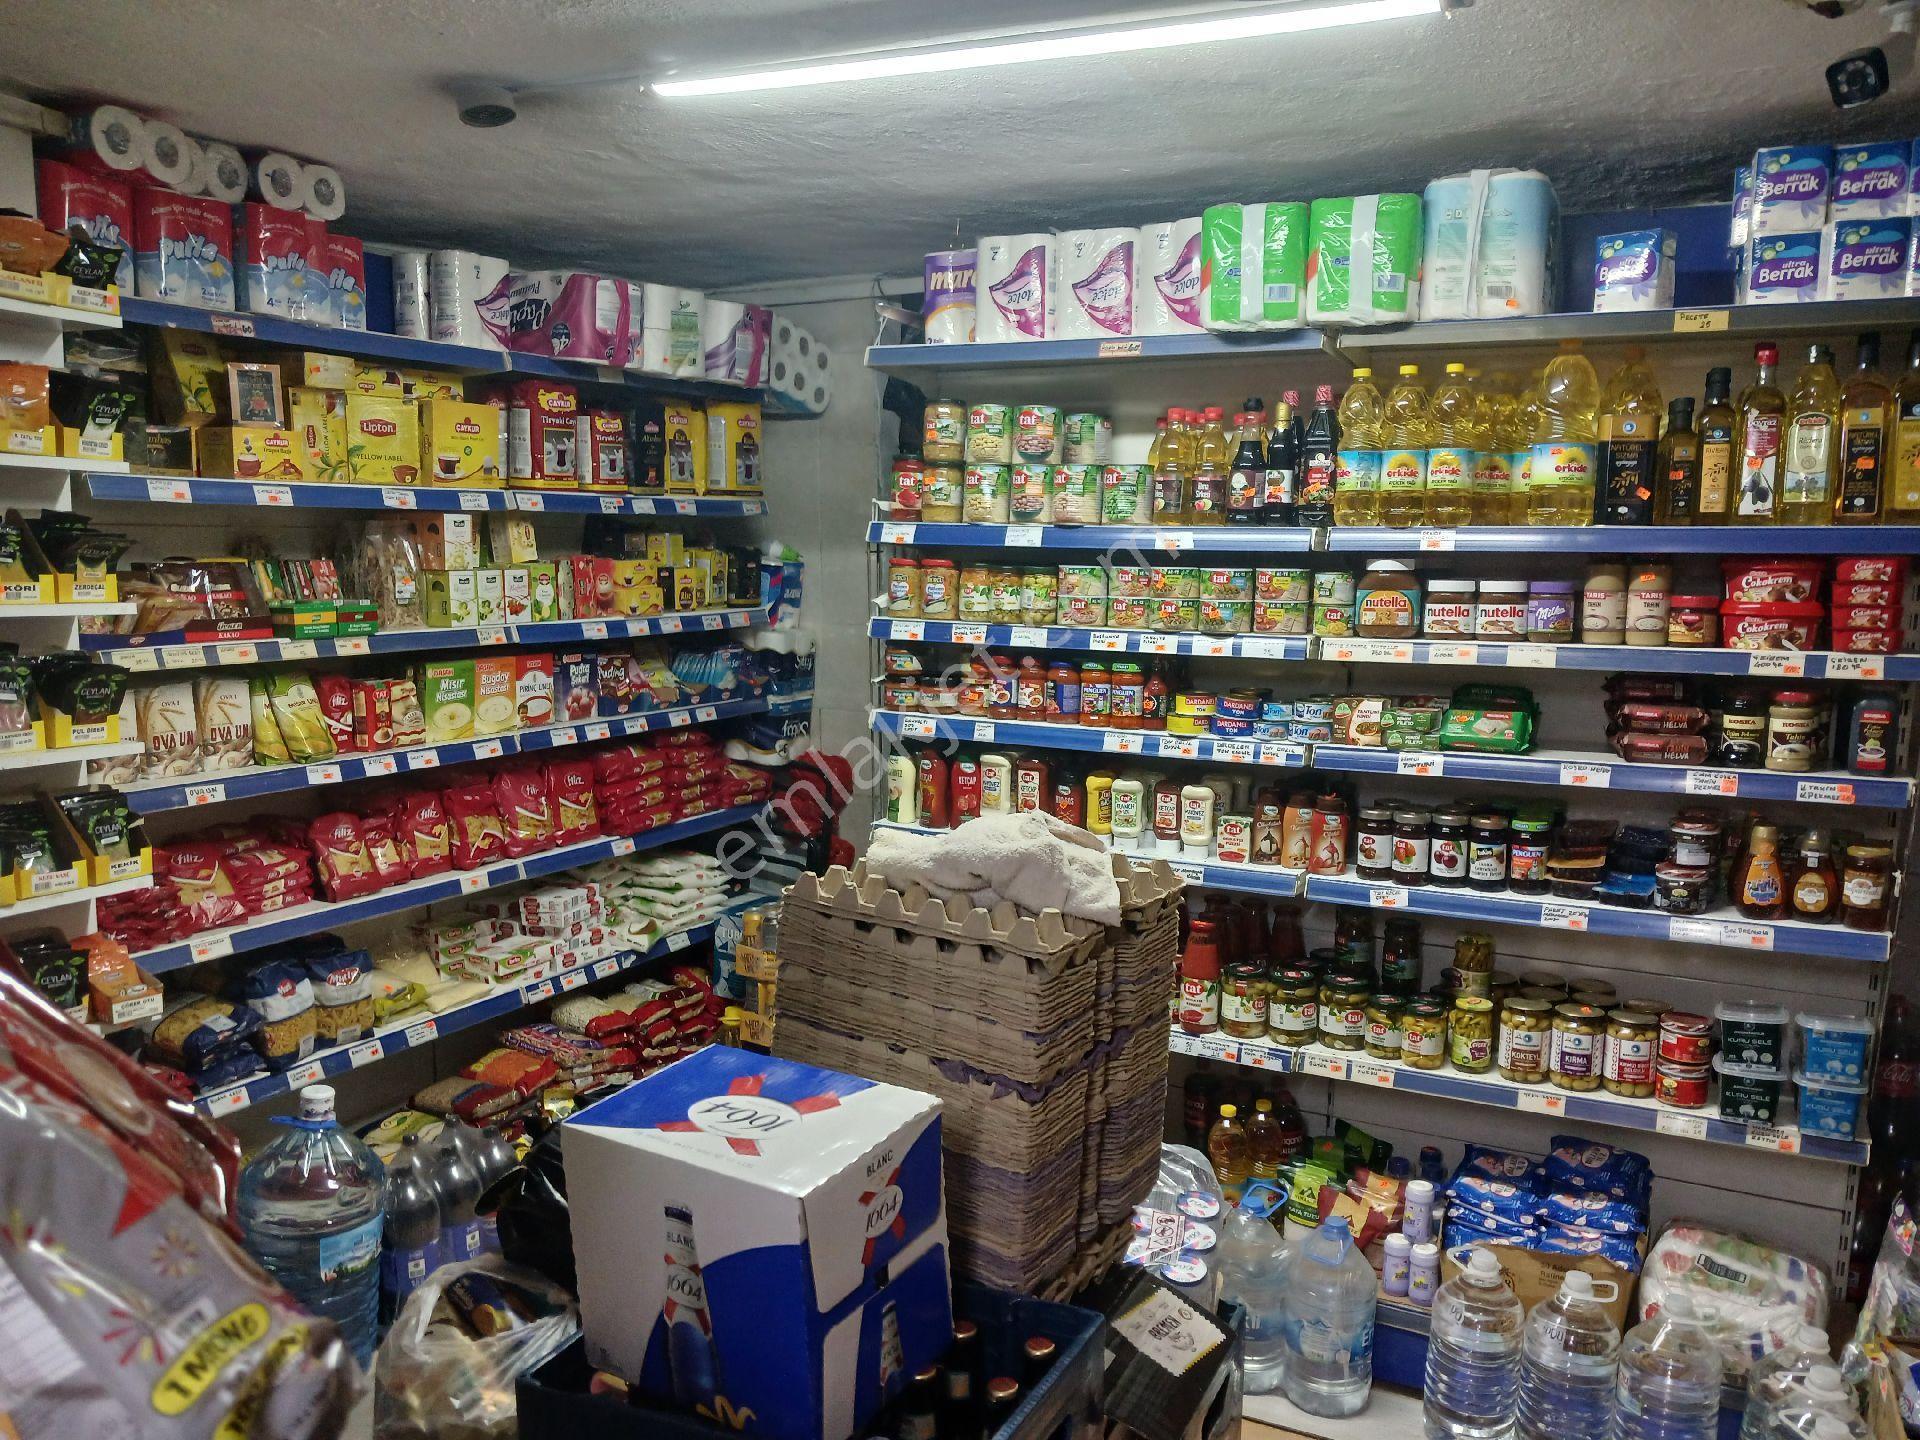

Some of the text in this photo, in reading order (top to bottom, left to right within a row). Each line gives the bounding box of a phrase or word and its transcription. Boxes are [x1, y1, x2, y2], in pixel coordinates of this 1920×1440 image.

[1786, 173, 1811, 183] ultra
[1864, 170, 1890, 181] ultra
[1763, 178, 1819, 196] Berrak
[1839, 176, 1898, 197] Berrak
[1866, 246, 1891, 255] ultra
[1840, 250, 1899, 269] Berrak
[1782, 261, 1806, 269] ultra
[1758, 265, 1814, 283] Berrak
[1007, 288, 1033, 306] dolce
[1093, 284, 1124, 304] dolce
[541, 416, 564, 426] Tiryaki
[971, 414, 984, 425] tat
[1019, 414, 1037, 425] tat
[361, 421, 395, 434] Lipton
[455, 424, 480, 433] ÇAYKUR
[357, 453, 403, 462] YELLOW LABEL
[1387, 469, 1418, 478] orkide
[1431, 467, 1461, 478] orkide
[1555, 464, 1588, 474] orkide
[900, 476, 915, 485] tat
[966, 474, 979, 485] tat
[1013, 474, 1026, 485] tat
[1119, 573, 1133, 581] tat
[1213, 574, 1228, 582] tat
[1258, 574, 1270, 582] tat
[1071, 602, 1087, 610] tat
[1113, 602, 1127, 611] tat
[1365, 596, 1407, 608] nutella
[1326, 611, 1342, 619] tat
[1427, 606, 1470, 618] nutella
[1480, 607, 1524, 618] nutella
[1536, 606, 1566, 619] Milka
[80, 687, 111, 696] CEYLAN
[1224, 702, 1254, 711] DARDANEL
[1305, 706, 1322, 716] Ton
[1663, 721, 1688, 730] HELVA
[210, 724, 249, 742] OVA UN
[153, 731, 194, 751] OVA UN
[1664, 752, 1690, 760] HELVA
[567, 774, 585, 786] filiz
[959, 776, 976, 787] KETÇAP
[421, 808, 440, 819] filiz
[1224, 825, 1240, 834] tat
[177, 854, 203, 864] filiz
[1184, 984, 1203, 994] tat
[1347, 1013, 1364, 1023] tat
[1373, 1026, 1385, 1034] tat
[1408, 1033, 1422, 1042] tat
[1751, 1038, 1773, 1046] SELE
[1511, 1051, 1542, 1061] KOKTEYL
[1565, 1054, 1588, 1065] KIRMA
[1750, 1093, 1771, 1102] SELE
[697, 1100, 793, 1133] 1664
[866, 1148, 894, 1178] BLANC
[866, 1197, 900, 1233] 1664
[666, 1231, 694, 1251] BLANC
[666, 1273, 702, 1298] 1664
